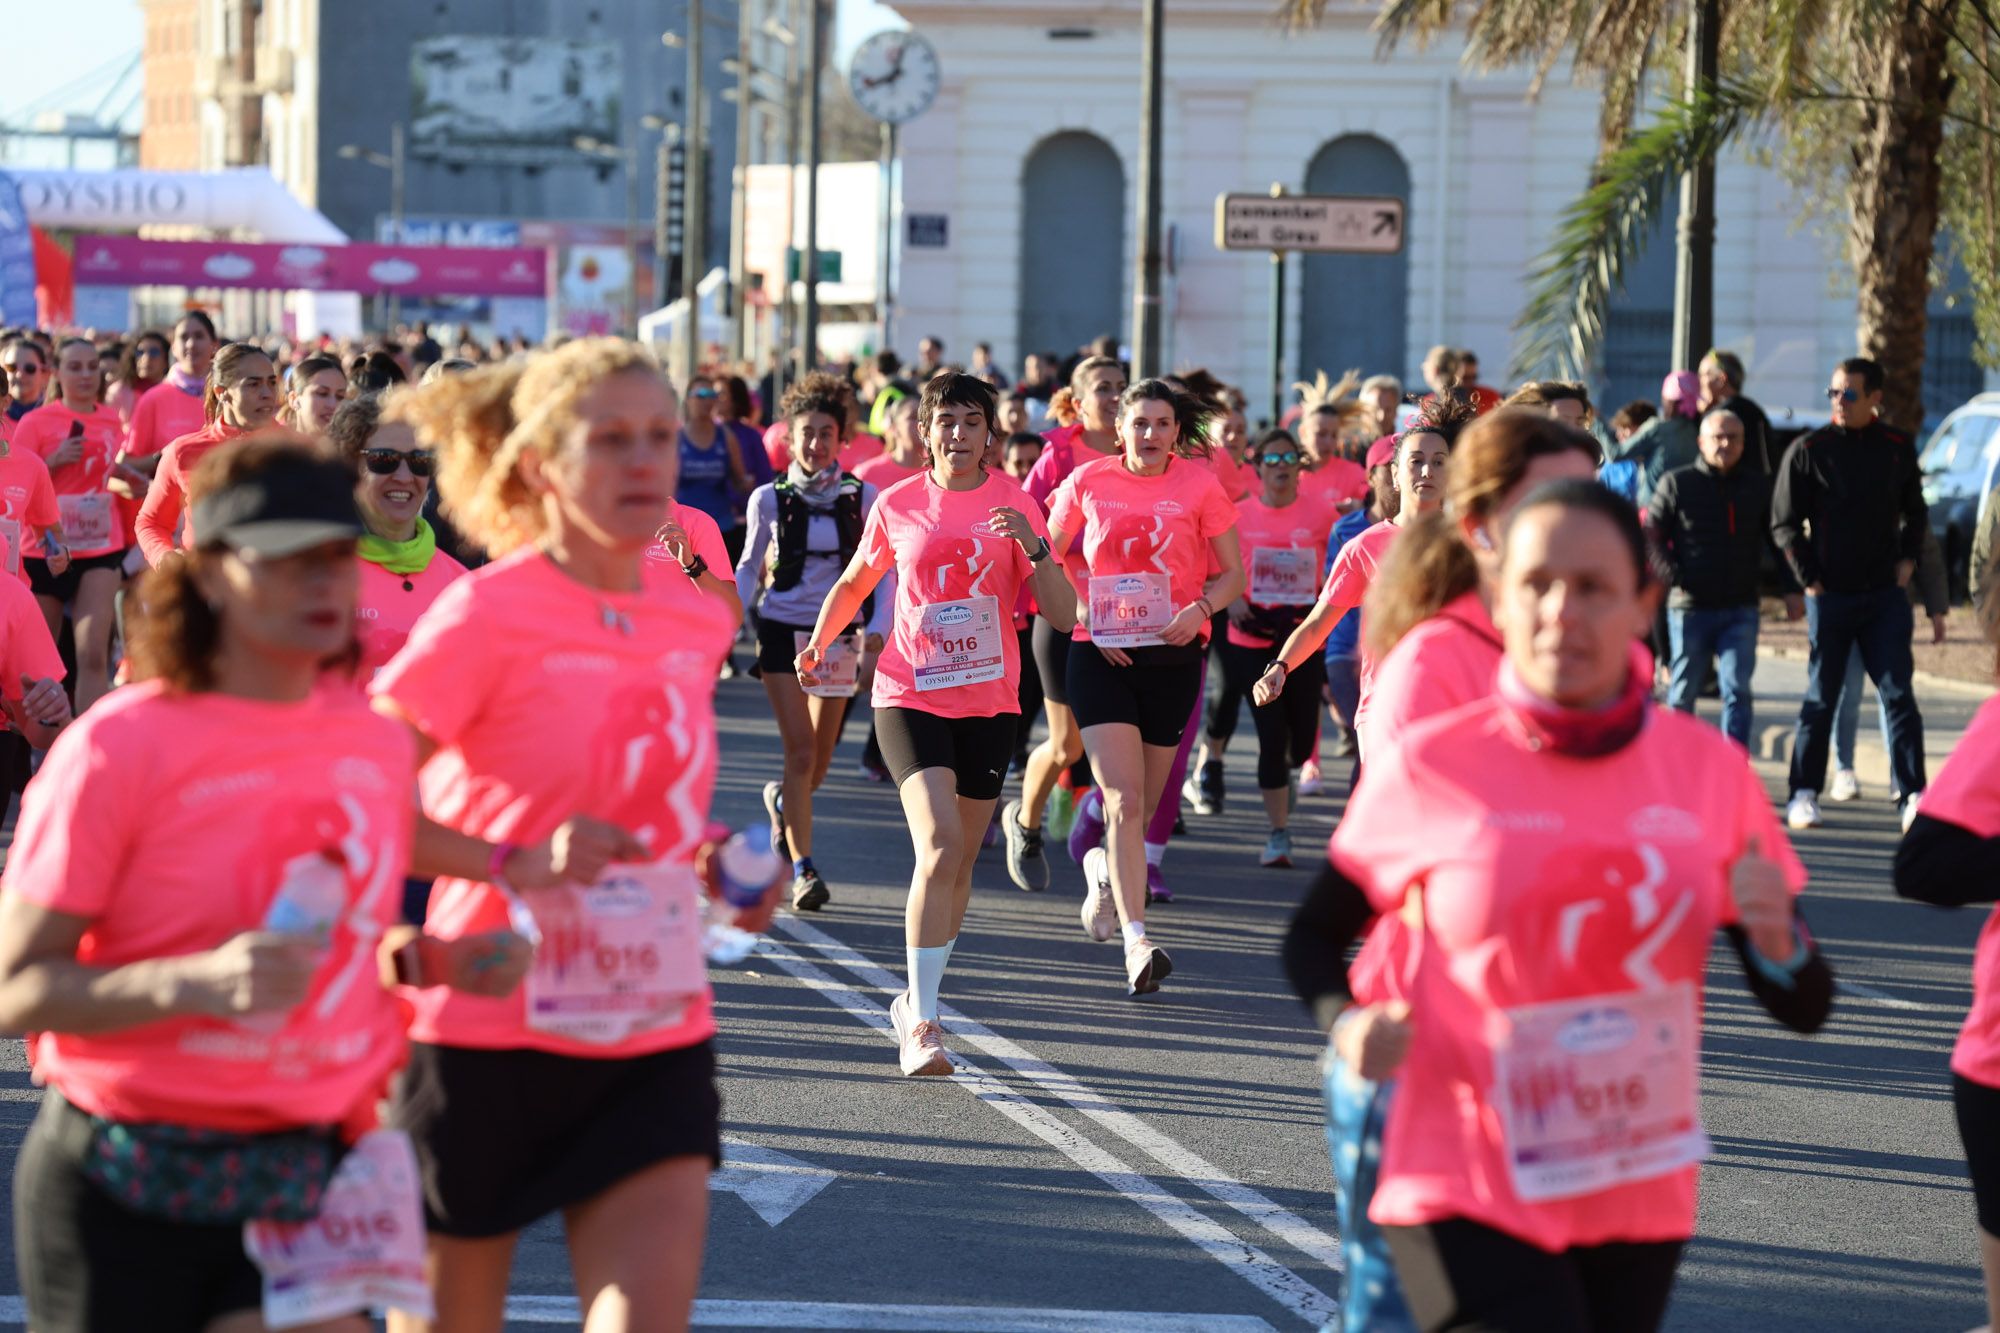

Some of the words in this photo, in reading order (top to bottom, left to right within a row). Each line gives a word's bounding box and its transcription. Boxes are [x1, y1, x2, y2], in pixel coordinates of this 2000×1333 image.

[15, 176, 186, 216] OYSHO
[939, 613, 971, 622] ASTURIANA
[1118, 606, 1148, 618] 016
[943, 637, 977, 653] 016
[951, 655, 969, 663] 2253
[925, 675, 955, 685] OYSHO
[972, 670, 996, 679] Santander
[596, 942, 659, 976] 016
[1575, 1075, 1647, 1118] 016
